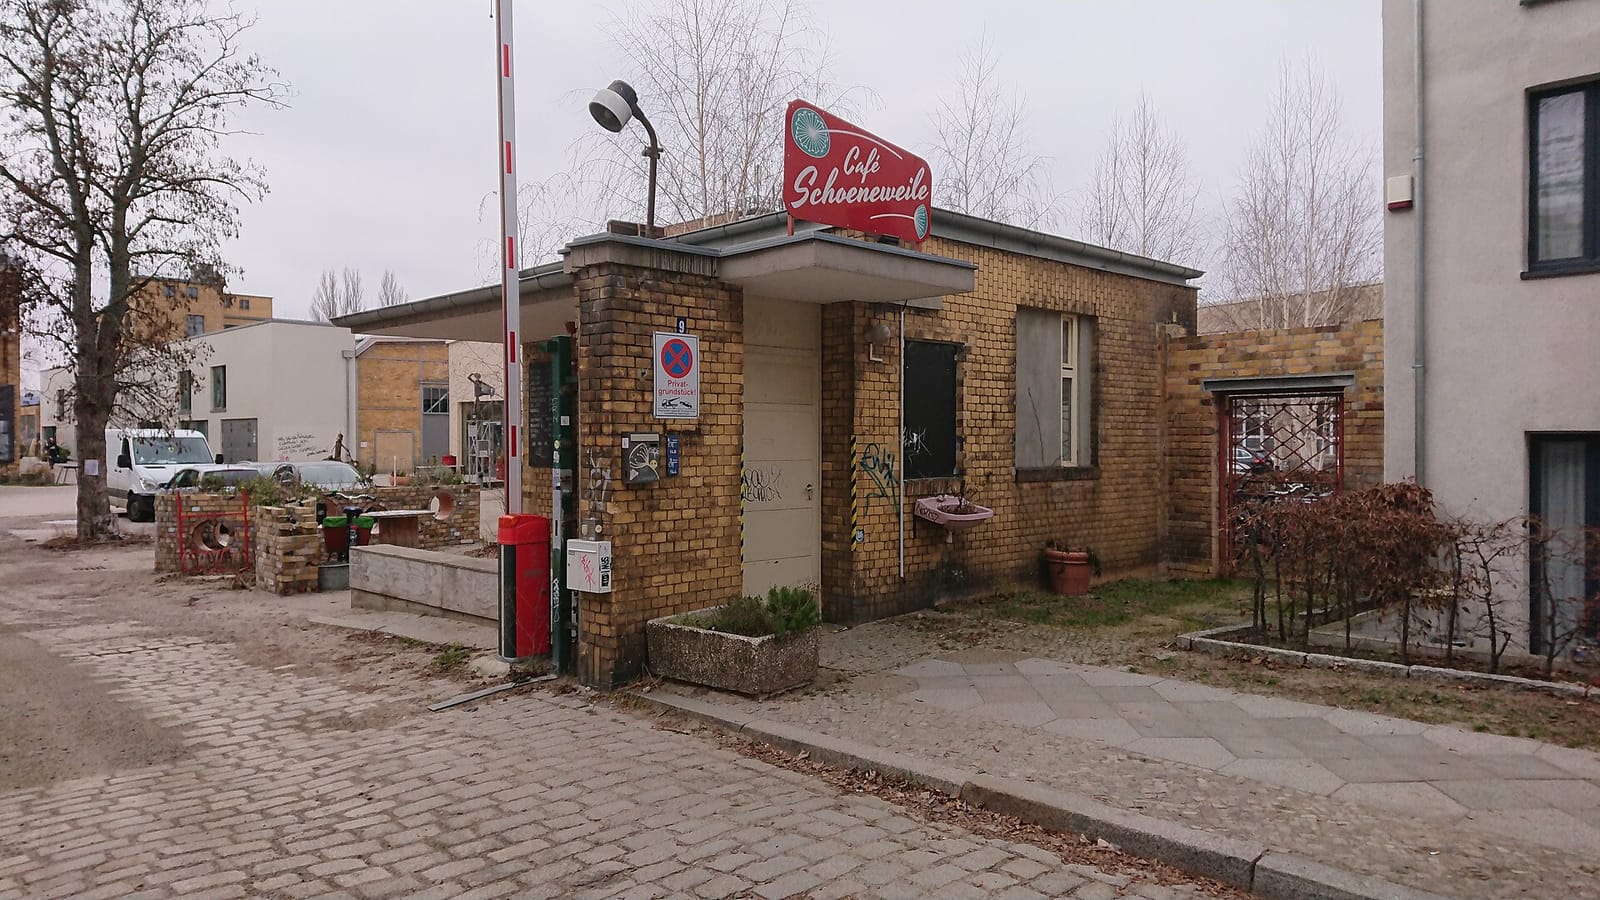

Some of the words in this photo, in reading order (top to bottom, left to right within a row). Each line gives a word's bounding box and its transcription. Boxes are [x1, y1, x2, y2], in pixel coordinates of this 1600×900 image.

[843, 145, 881, 184] Café
[790, 165, 929, 209] Schoeneweile
[678, 320, 685, 333] 9
[667, 379, 689, 388] Privat-
[658, 388, 696, 396] grundstück!
